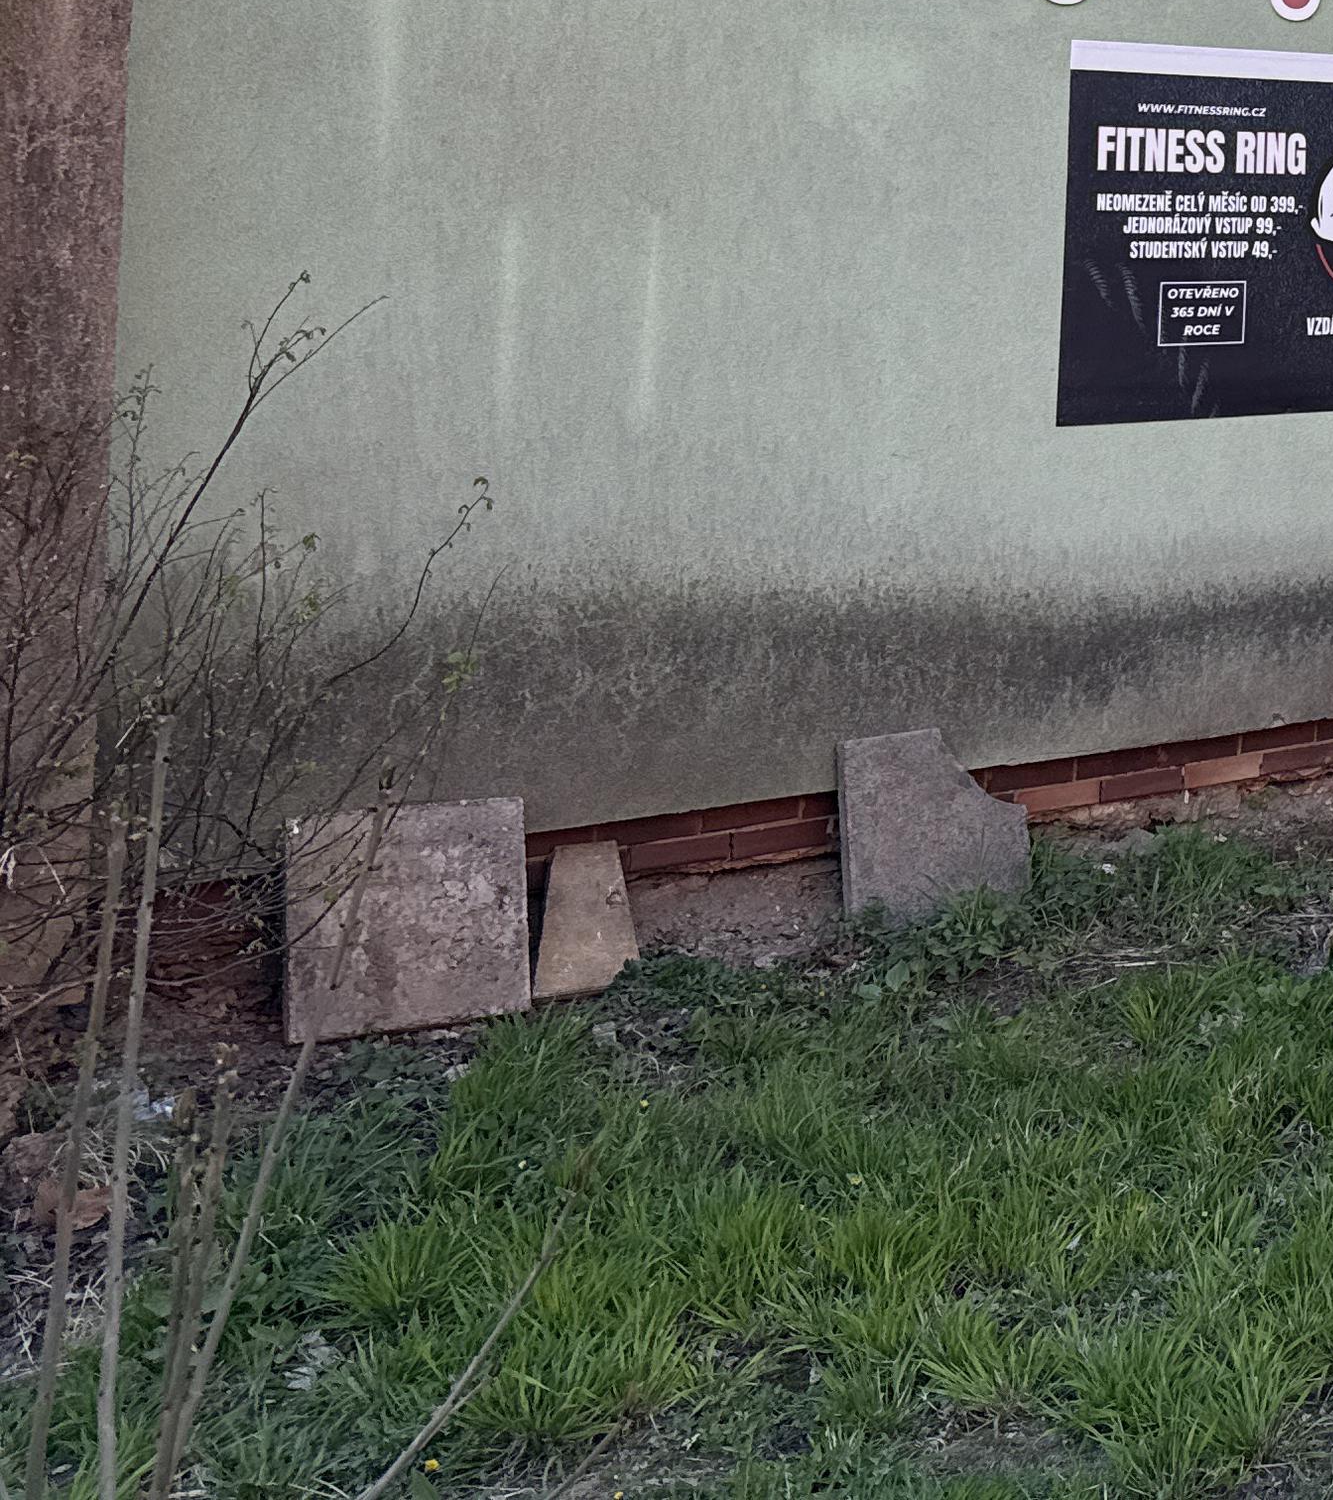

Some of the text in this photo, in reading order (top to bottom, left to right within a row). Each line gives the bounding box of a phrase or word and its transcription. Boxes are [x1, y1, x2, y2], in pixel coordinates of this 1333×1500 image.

[1137, 102, 1267, 117] WWW.FITNESSRING.CZ
[1097, 126, 1307, 175] FITNESS RING
[1096, 189, 1304, 215] NEOMEZENĚ CELÝ MĚSÍC OD 399,-
[1123, 213, 1282, 236] JEDNORÁZOVÝ VSTUP 99,-
[1129, 237, 1278, 260] STUDENTSKÝ VSTUP 49,-
[1167, 285, 1239, 300] OTEVŘENO
[1170, 304, 1235, 318] 365 DNÍ V
[1183, 324, 1221, 336] ROCE
